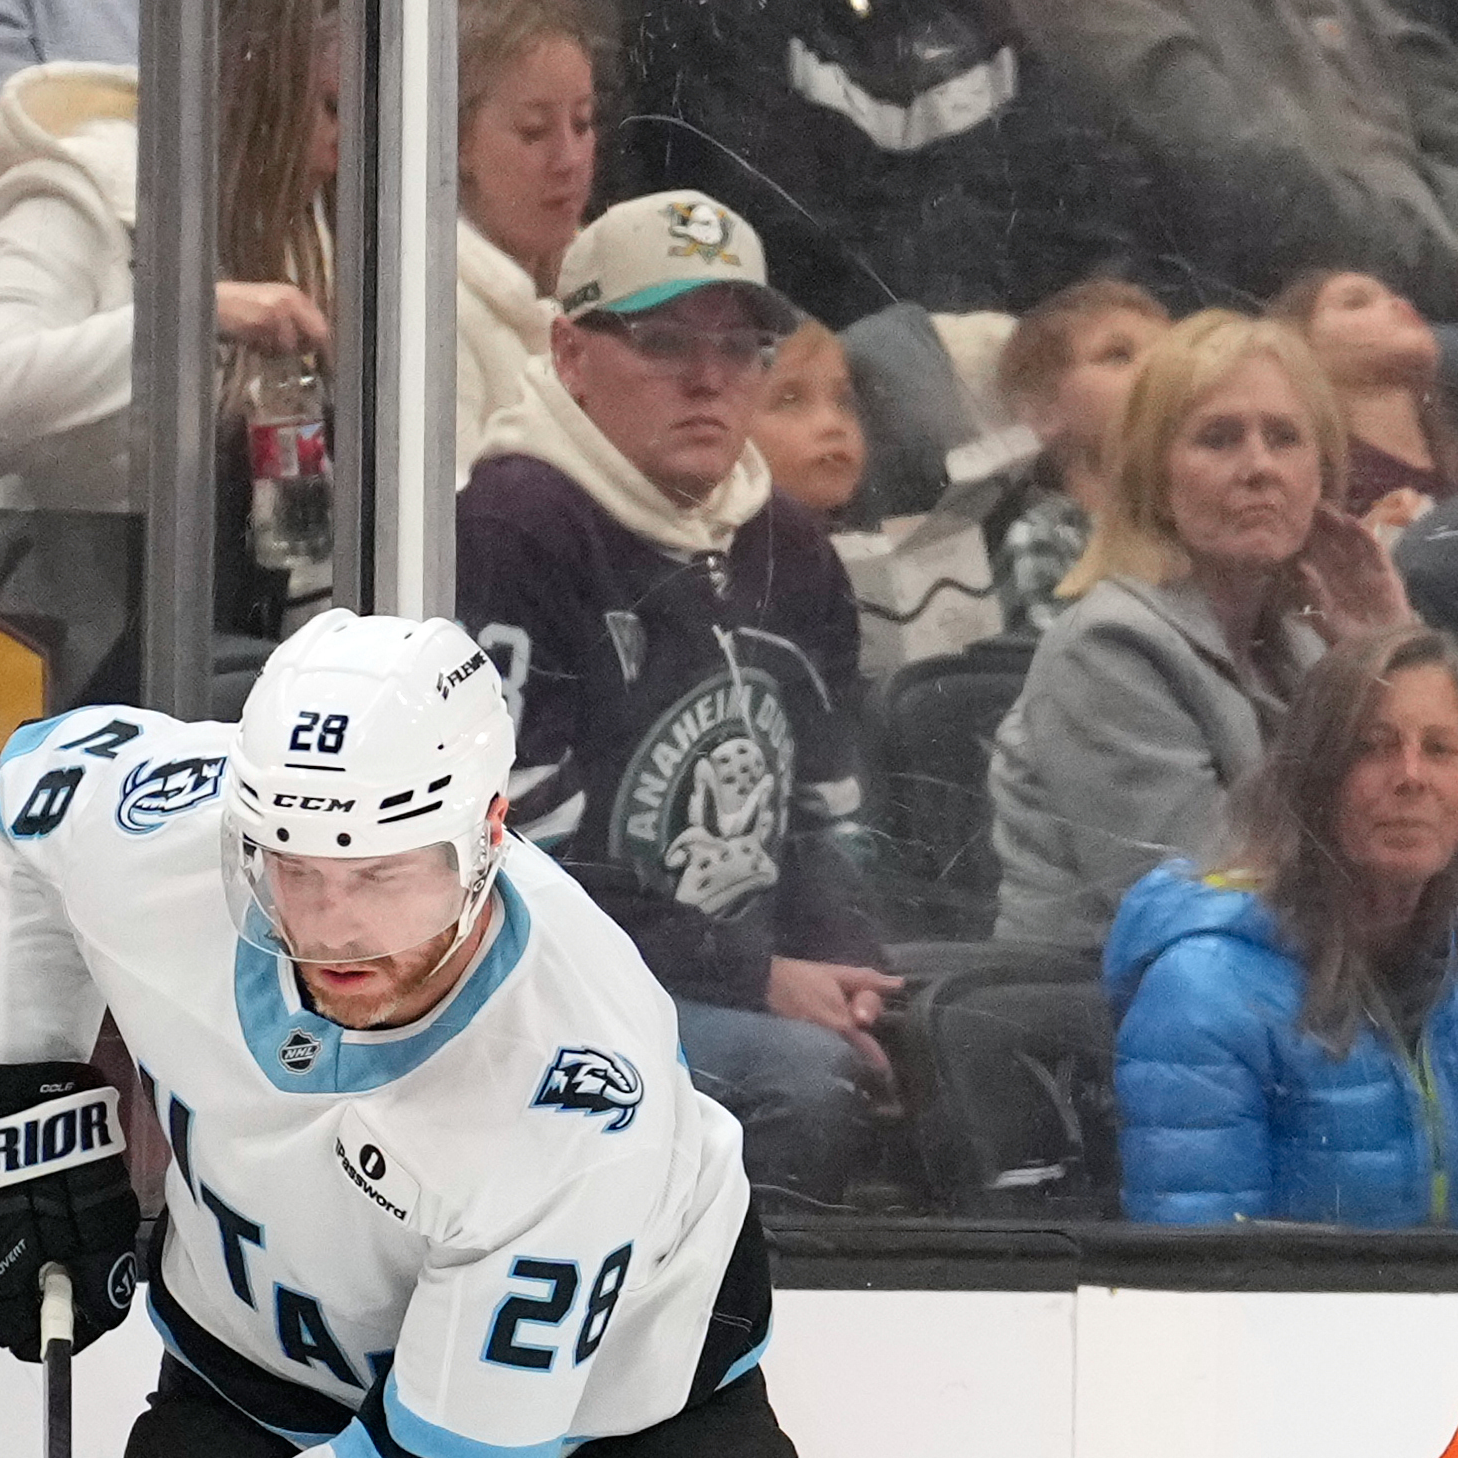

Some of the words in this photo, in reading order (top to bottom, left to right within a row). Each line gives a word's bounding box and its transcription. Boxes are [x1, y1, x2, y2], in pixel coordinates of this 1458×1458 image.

[288, 710, 350, 755] 28
[272, 793, 356, 813] CCM
[285, 1046, 317, 1060] NHL
[480, 1239, 635, 1373] 28
